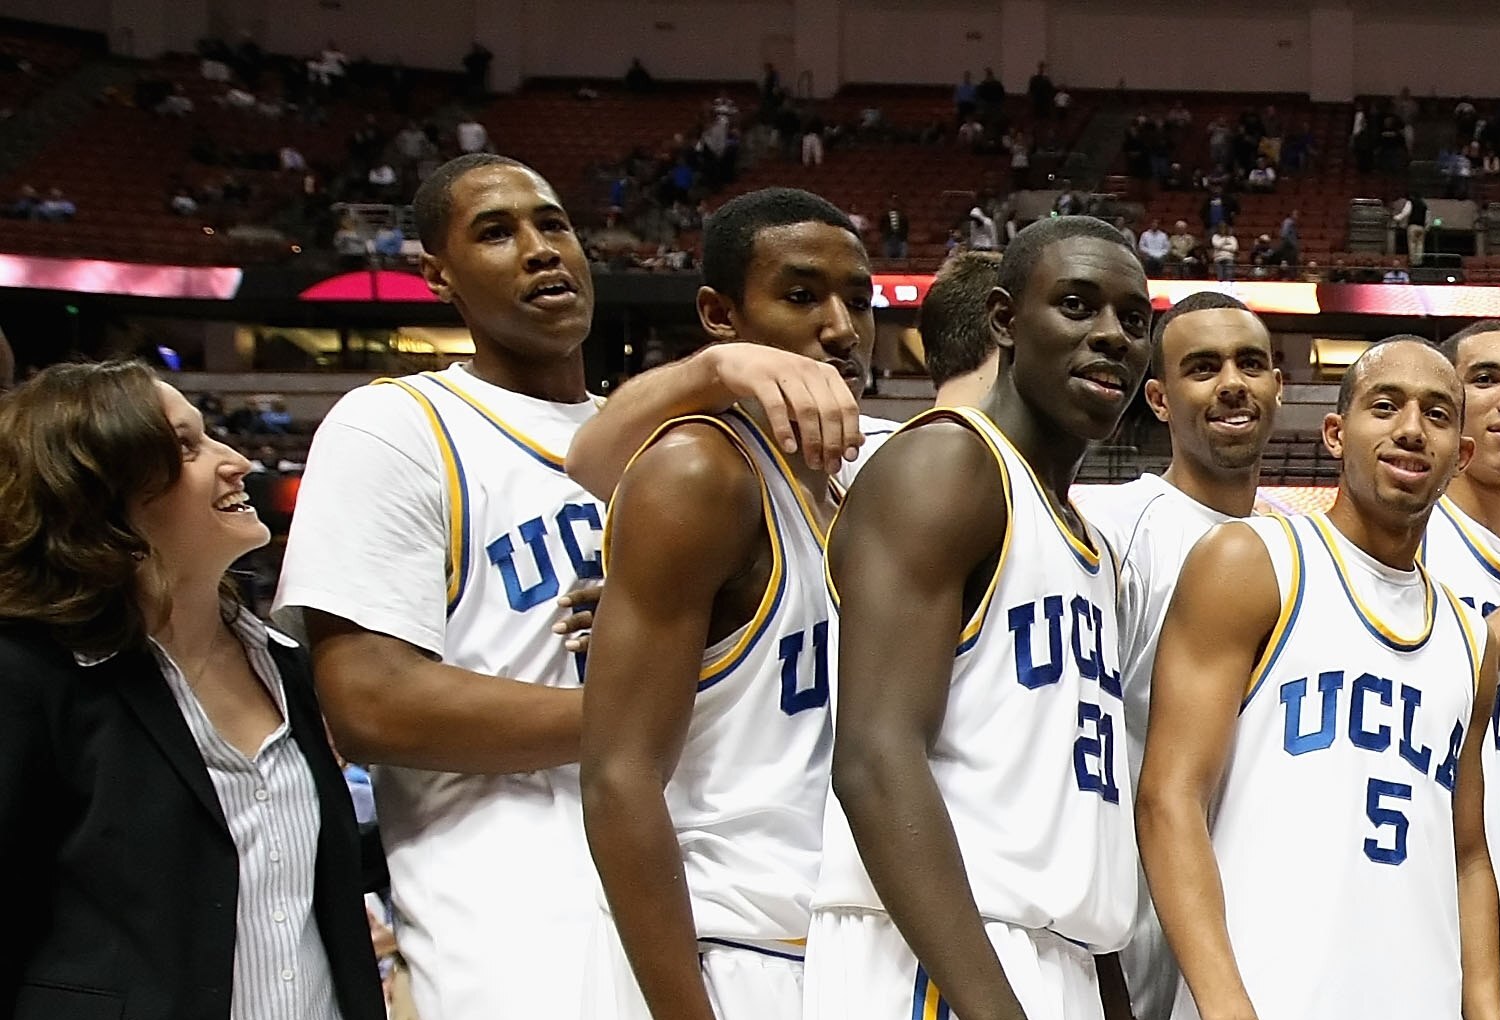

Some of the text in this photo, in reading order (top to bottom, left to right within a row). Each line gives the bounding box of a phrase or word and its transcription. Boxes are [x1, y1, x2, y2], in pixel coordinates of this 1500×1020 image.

[486, 503, 603, 613] UC
[1008, 594, 1123, 699] UCL
[1074, 701, 1119, 805] 21
[1280, 670, 1463, 792] UCLA
[1363, 777, 1412, 865] 5
